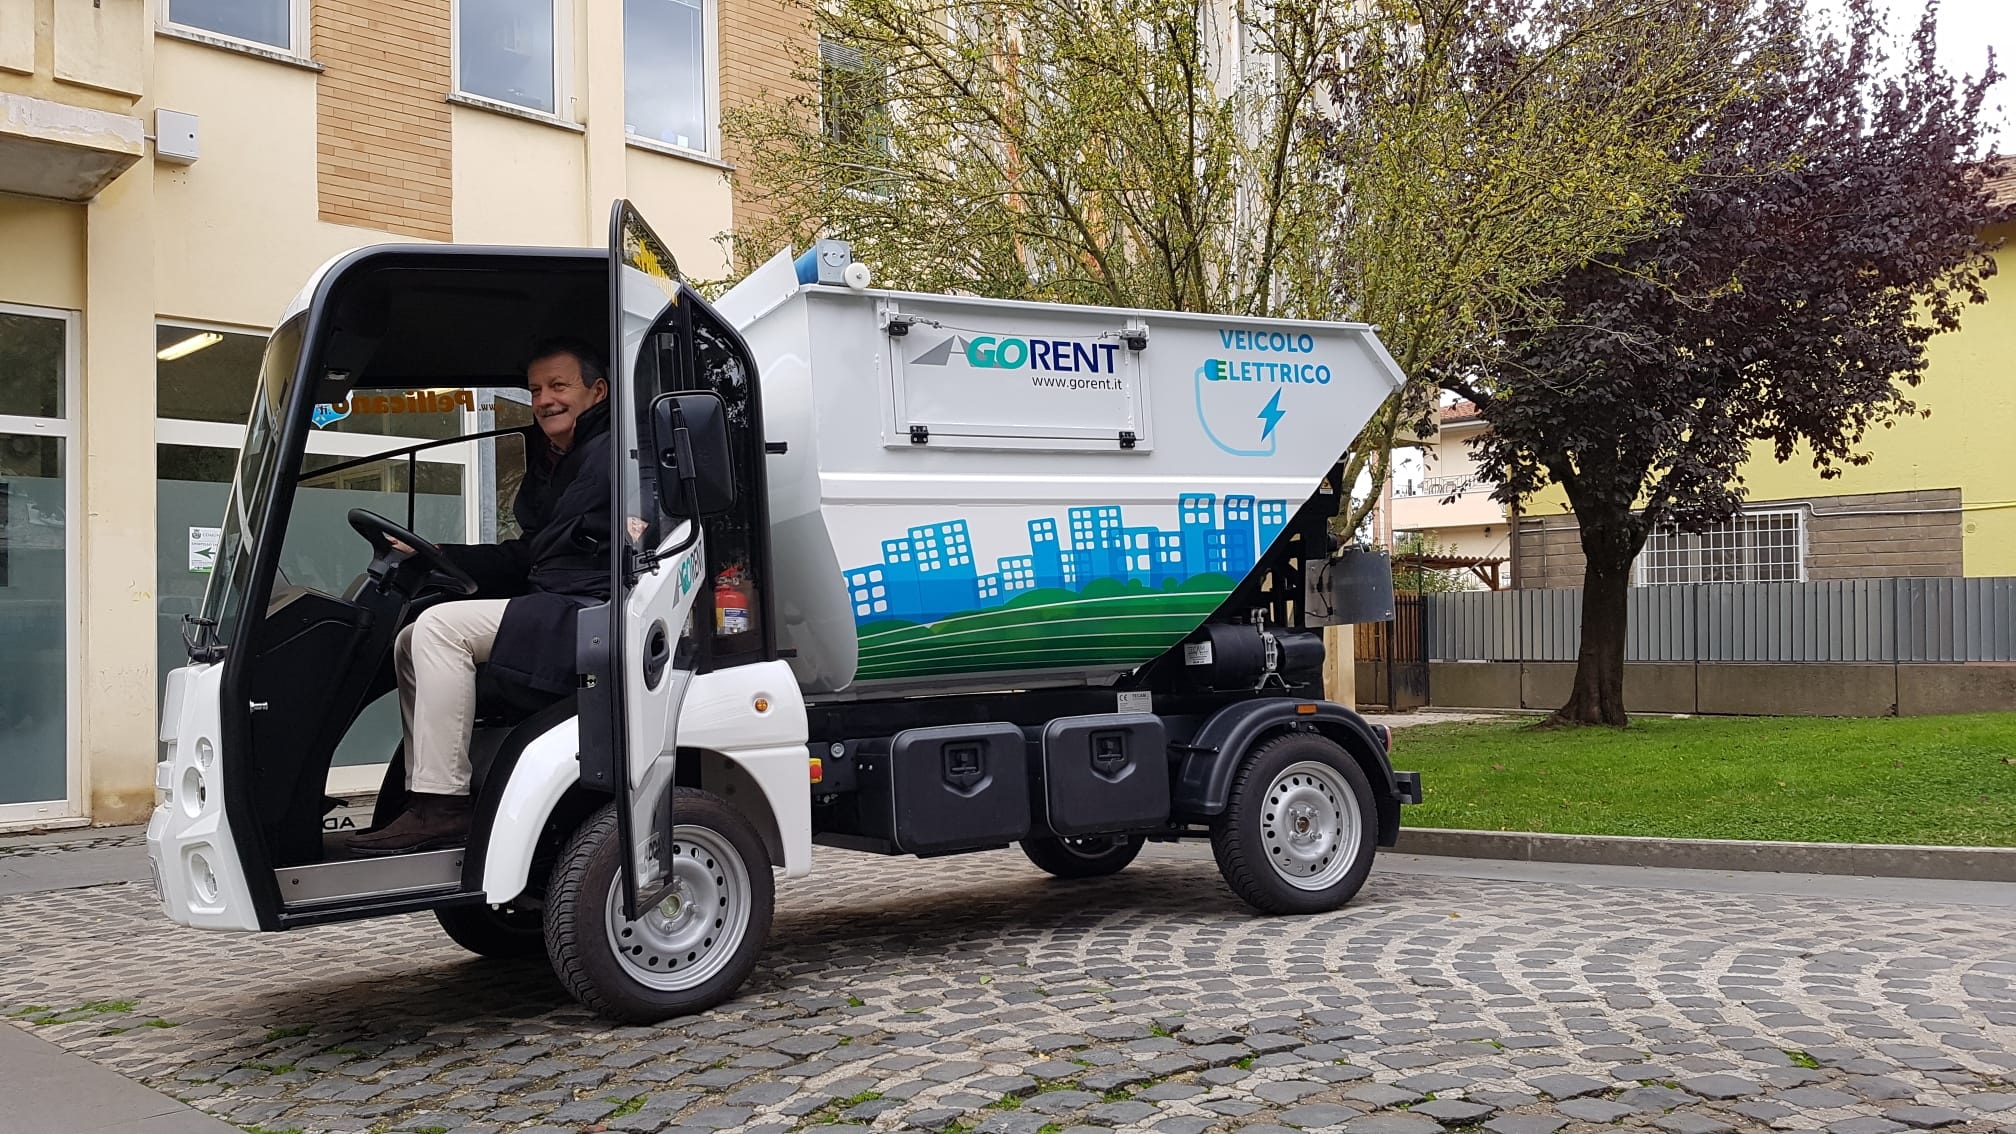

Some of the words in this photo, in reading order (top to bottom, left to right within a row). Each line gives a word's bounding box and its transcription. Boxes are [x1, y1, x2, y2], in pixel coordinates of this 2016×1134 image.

[1219, 329, 1314, 353] VEICOLO
[967, 336, 1119, 373] GORENT
[1032, 376, 1123, 390] www.gorent.it
[1217, 360, 1331, 384] ELETTRICO
